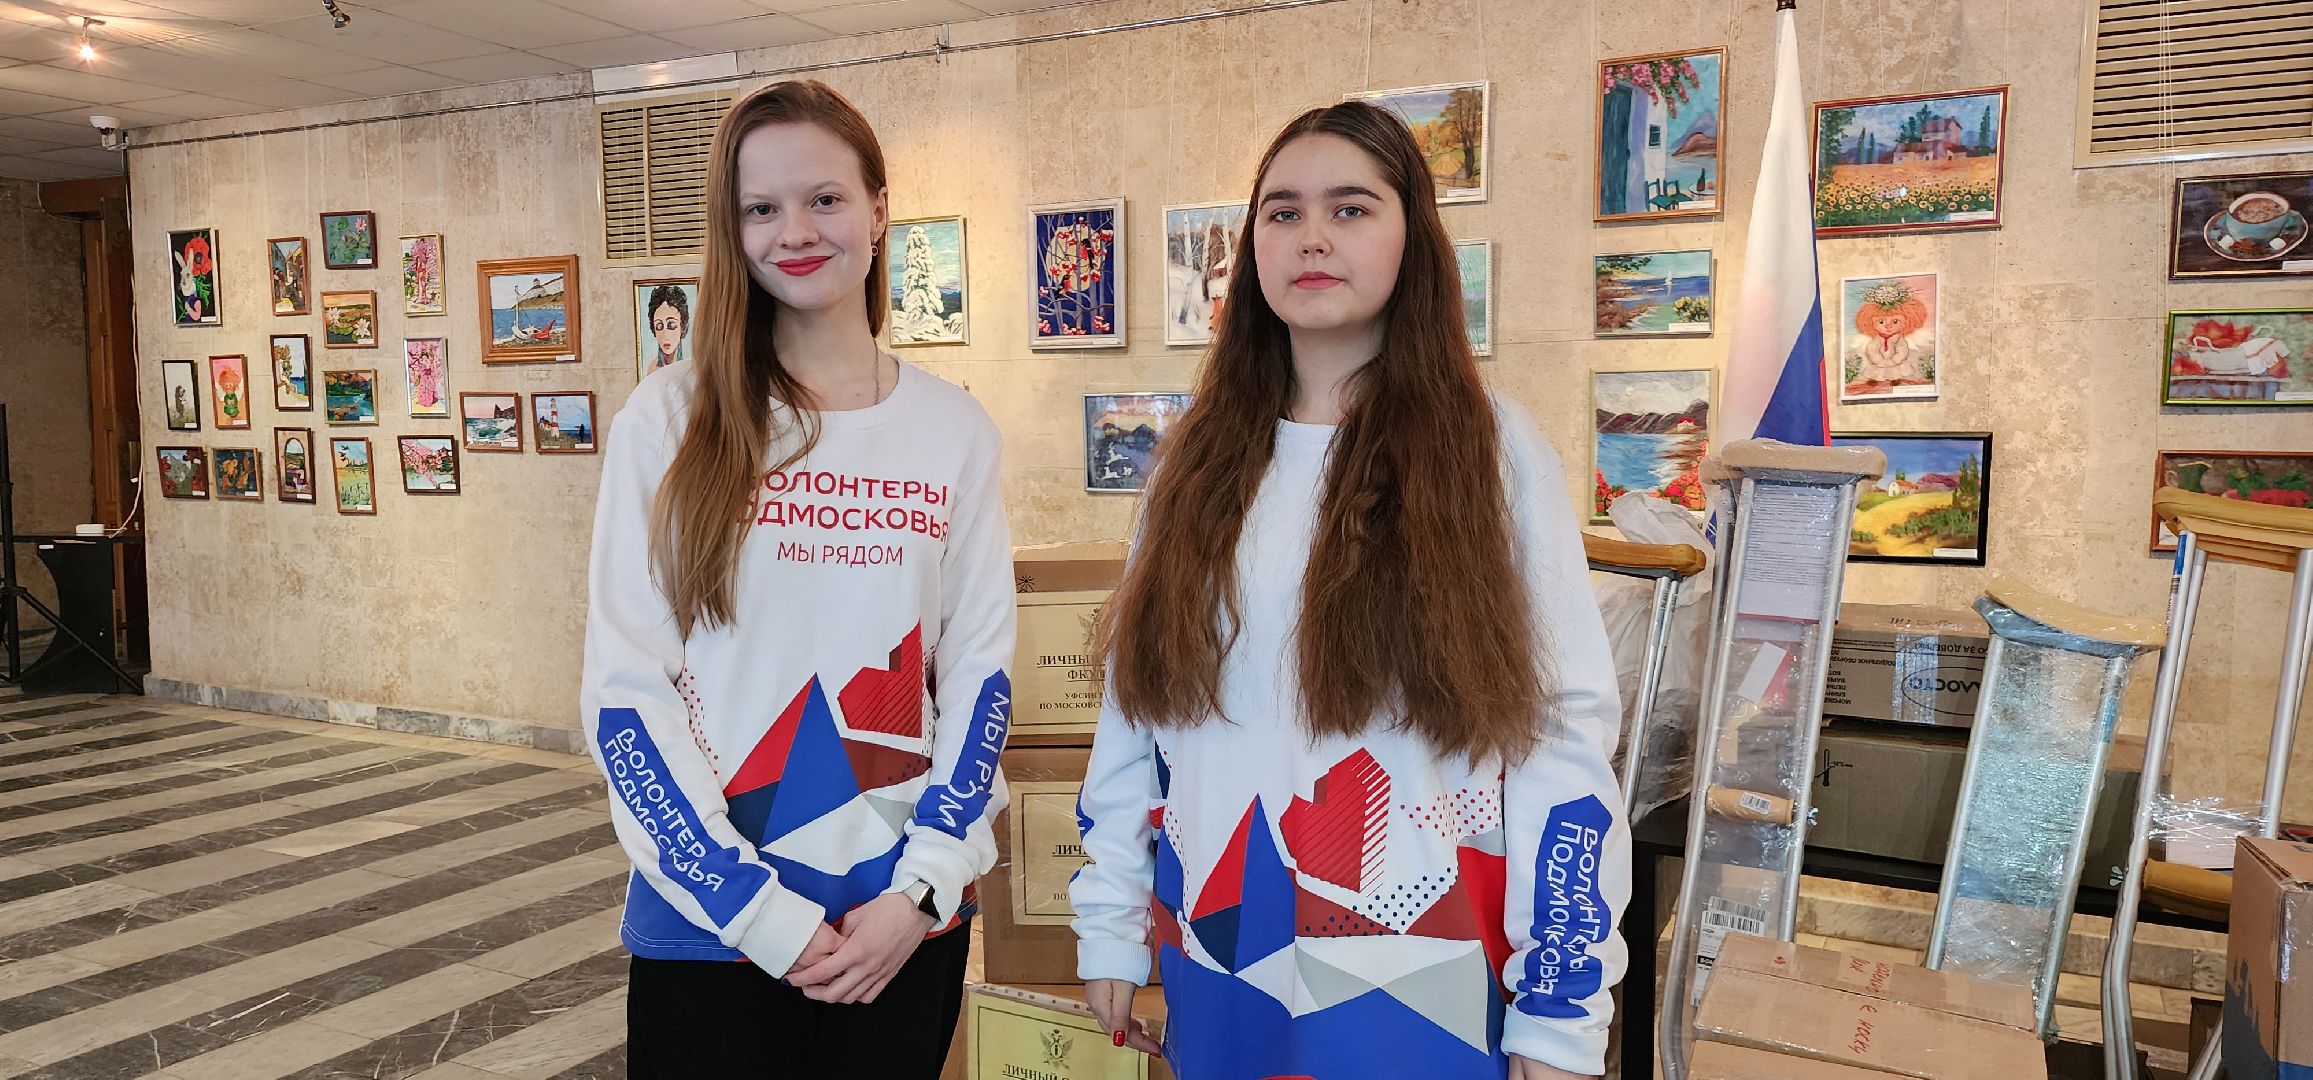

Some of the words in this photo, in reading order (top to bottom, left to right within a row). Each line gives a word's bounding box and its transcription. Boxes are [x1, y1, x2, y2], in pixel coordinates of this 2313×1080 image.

[754, 469, 948, 506] ОЛОНТЕРЫ
[745, 500, 949, 543] ДМОСКОВЬЯ
[777, 541, 815, 563] МЫ
[822, 544, 903, 568] РЯДОМ
[1037, 654, 1092, 665] ЛИЧНЫ
[980, 691, 1009, 753] МЫ
[1052, 845, 1086, 854] ЛИЧ
